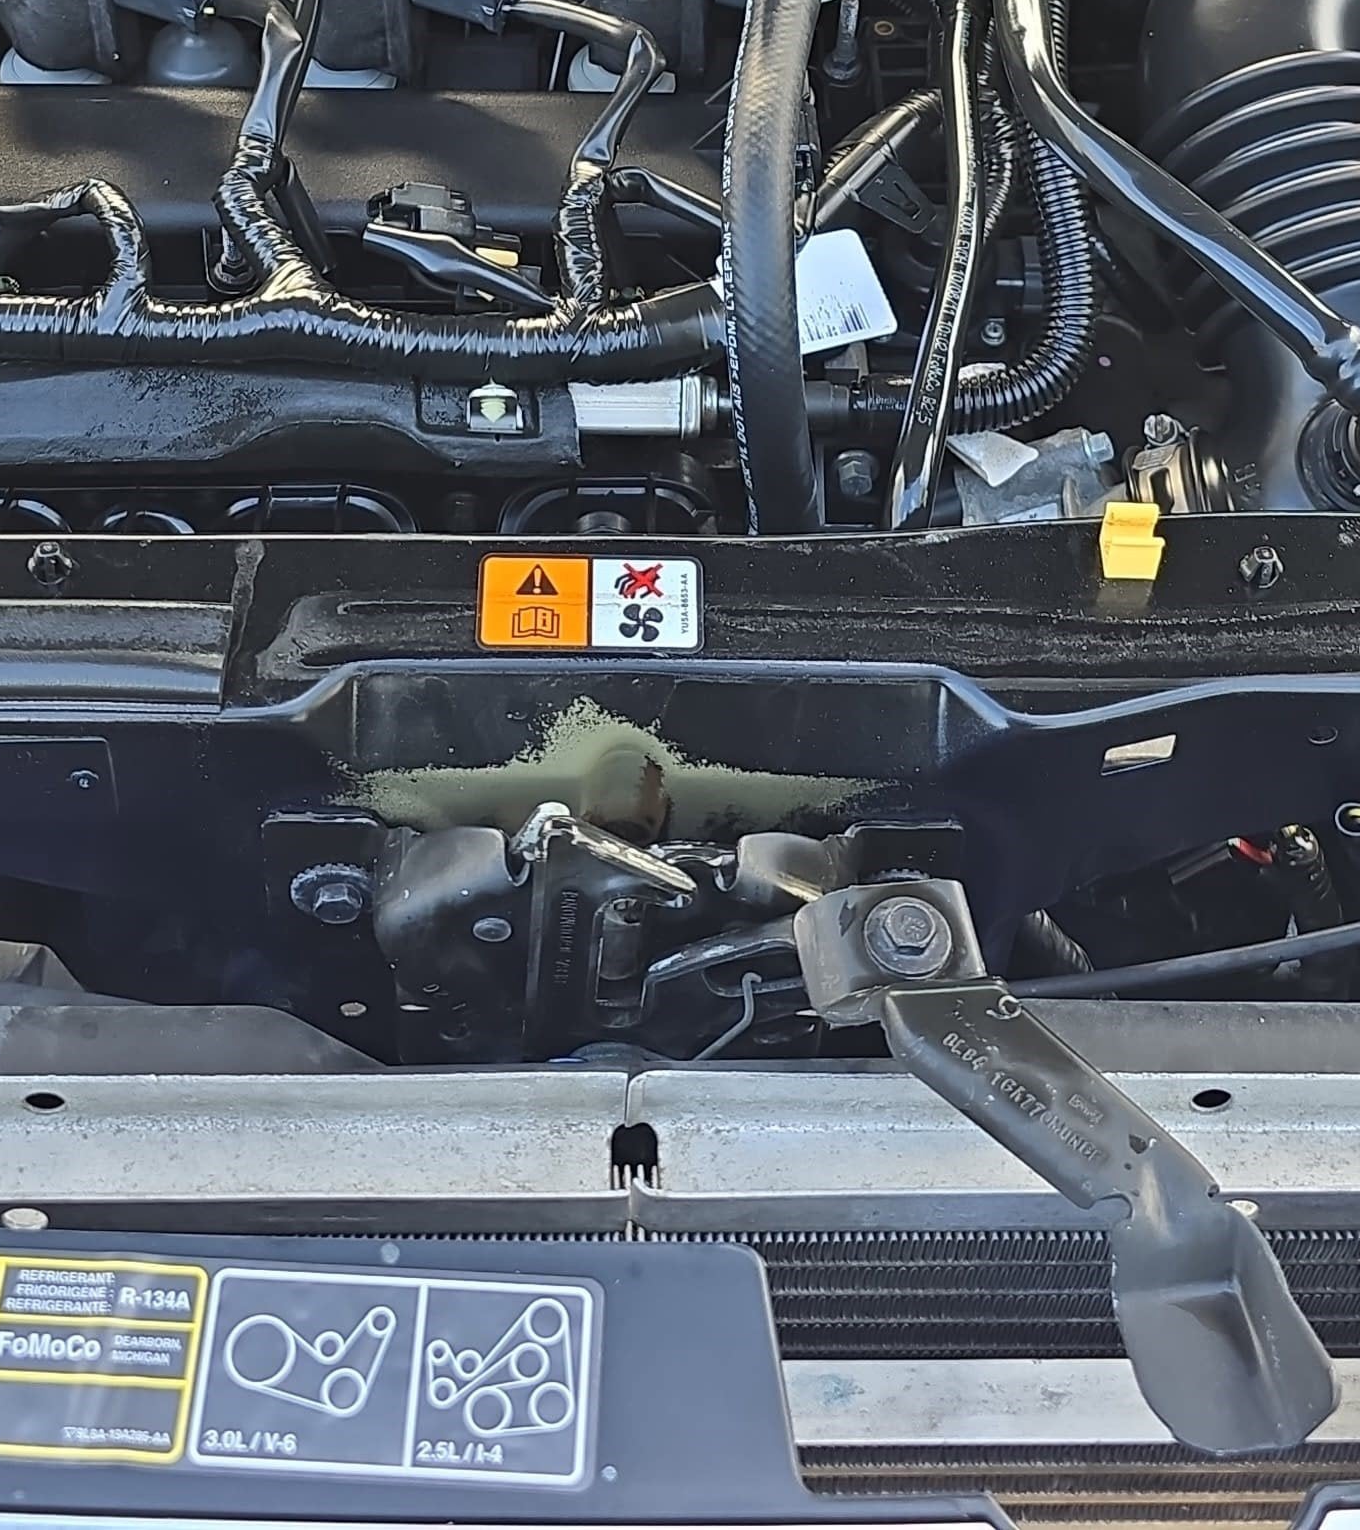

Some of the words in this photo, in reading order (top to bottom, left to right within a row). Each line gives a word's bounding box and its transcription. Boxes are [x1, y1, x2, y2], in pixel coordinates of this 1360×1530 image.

[734, 410, 746, 443] DOT
[20, 1270, 115, 1284] REFRIGERANT:
[118, 1287, 191, 1312] R-134A
[111, 1350, 171, 1366] MICHIGAN
[205, 1430, 253, 1452] 3.0L
[264, 1435, 298, 1455] V-6
[416, 1440, 460, 1463] 2.5L
[473, 1443, 504, 1466] I-4
